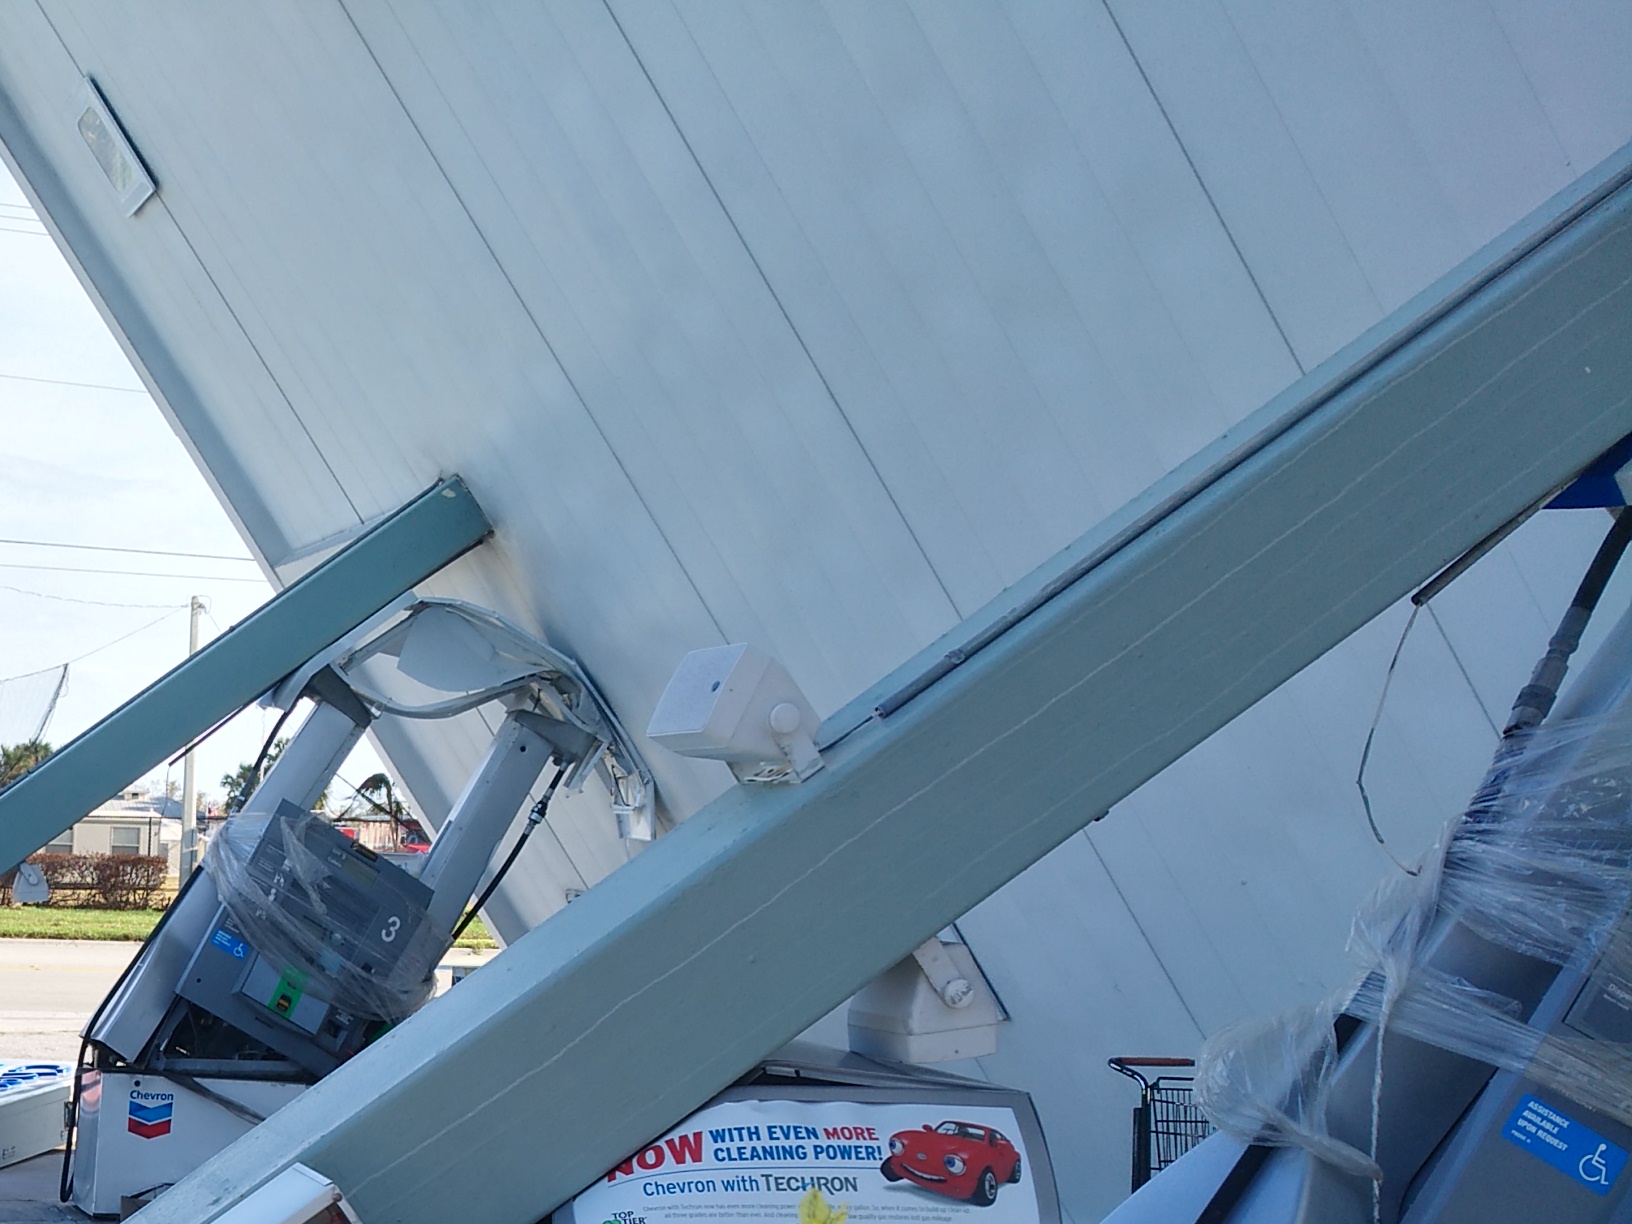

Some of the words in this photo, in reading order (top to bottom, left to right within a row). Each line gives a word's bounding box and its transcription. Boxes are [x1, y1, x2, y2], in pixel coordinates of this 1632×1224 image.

[381, 916, 401, 943] 3
[129, 1089, 174, 1101] Chevron
[1522, 1110, 1560, 1134] AVAILABLE
[1528, 1101, 1570, 1128] ASSISTANCE
[708, 1125, 762, 1144] WITH
[768, 1125, 820, 1141] EVEN
[823, 1126, 880, 1141] MORE
[1517, 1118, 1538, 1133] UPON
[1536, 1129, 1568, 1151] REQUEST
[713, 1145, 808, 1162] CLEANING
[814, 1145, 884, 1162] POWER!
[643, 1179, 717, 1197] Chevron
[721, 1175, 760, 1193] with
[760, 1174, 859, 1196] TECHRON
[611, 1210, 635, 1220] TOP
